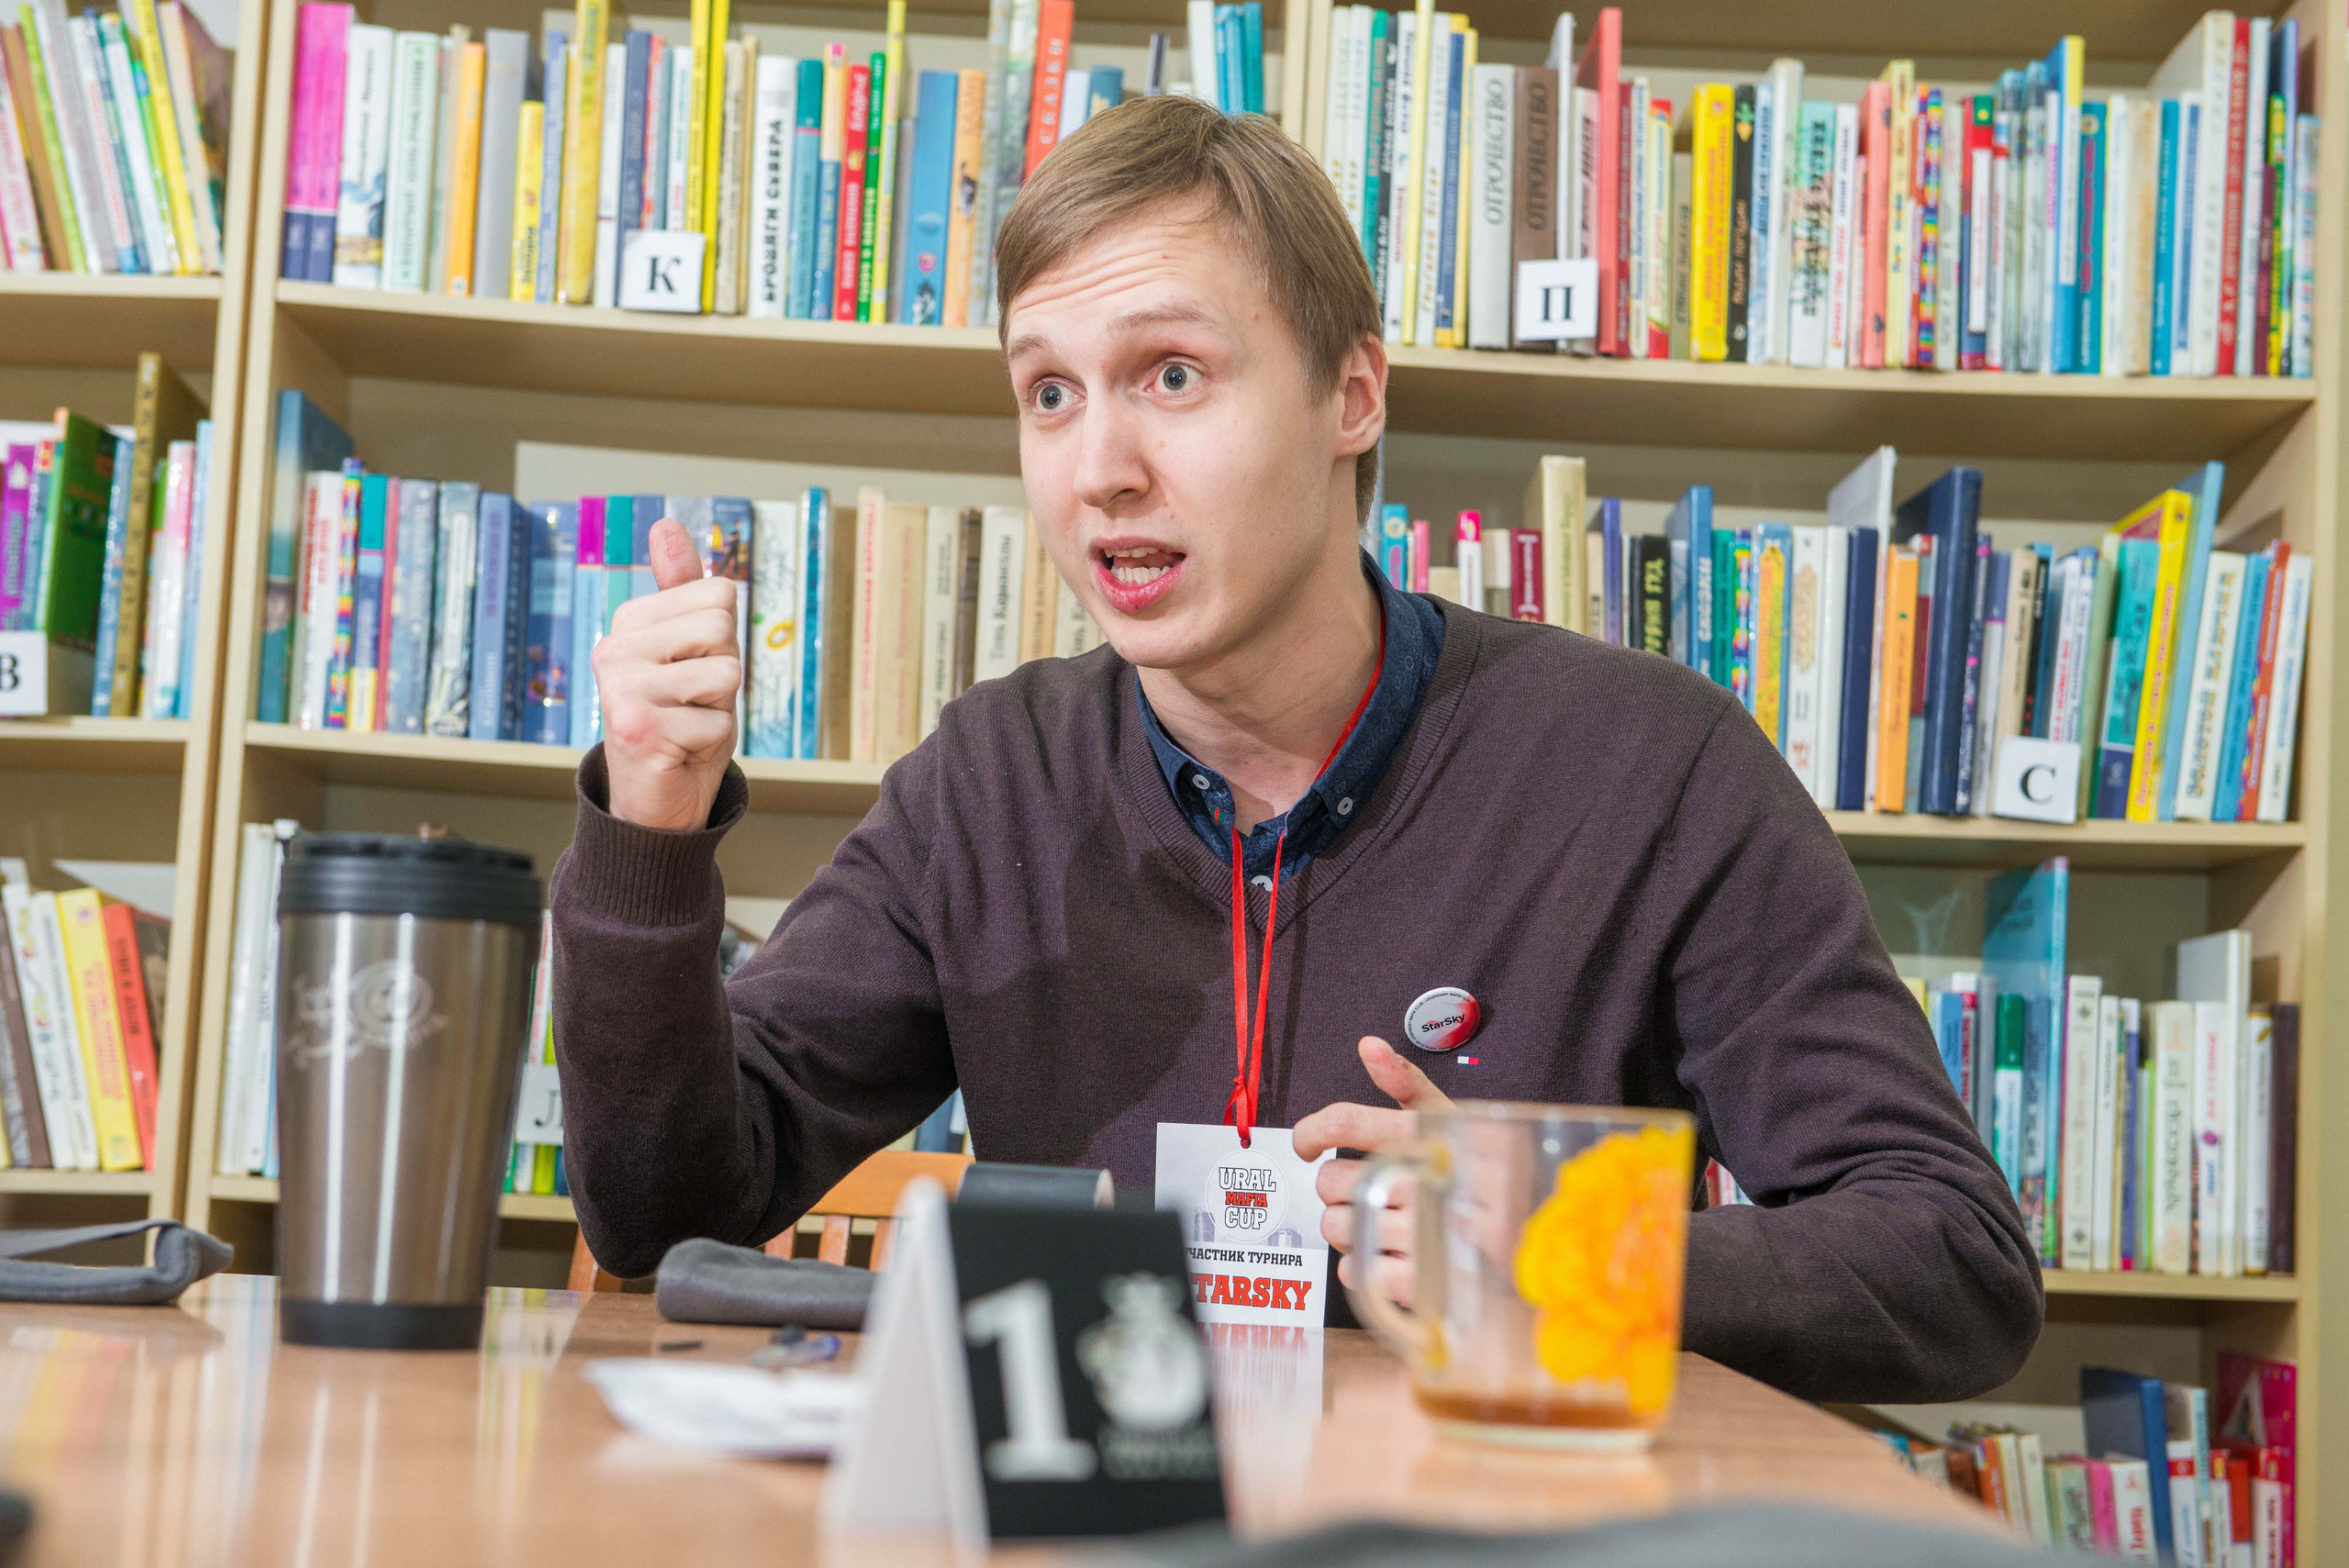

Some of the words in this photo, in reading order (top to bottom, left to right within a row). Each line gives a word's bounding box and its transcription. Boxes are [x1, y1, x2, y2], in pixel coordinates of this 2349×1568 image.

[765, 118, 784, 199] СЕВЕРА
[1485, 76, 1505, 227] ОТРОЧЕСТВО
[1527, 81, 1548, 233] ОТРОЧЕСТВО
[762, 205, 779, 303] БРОДЯГИ
[648, 257, 683, 294] К
[1541, 285, 1578, 323] П
[1414, 1002, 1424, 1011] CLUB
[1421, 1014, 1465, 1033] StarSky
[1219, 1167, 1276, 1192] URAL
[1225, 1191, 1268, 1207] MAFIA
[1225, 1207, 1267, 1229] CUP
[1248, 1251, 1303, 1267] ТУРНИРА
[1189, 1273, 1312, 1311] TARSKY
[963, 1275, 1100, 1483] 1
